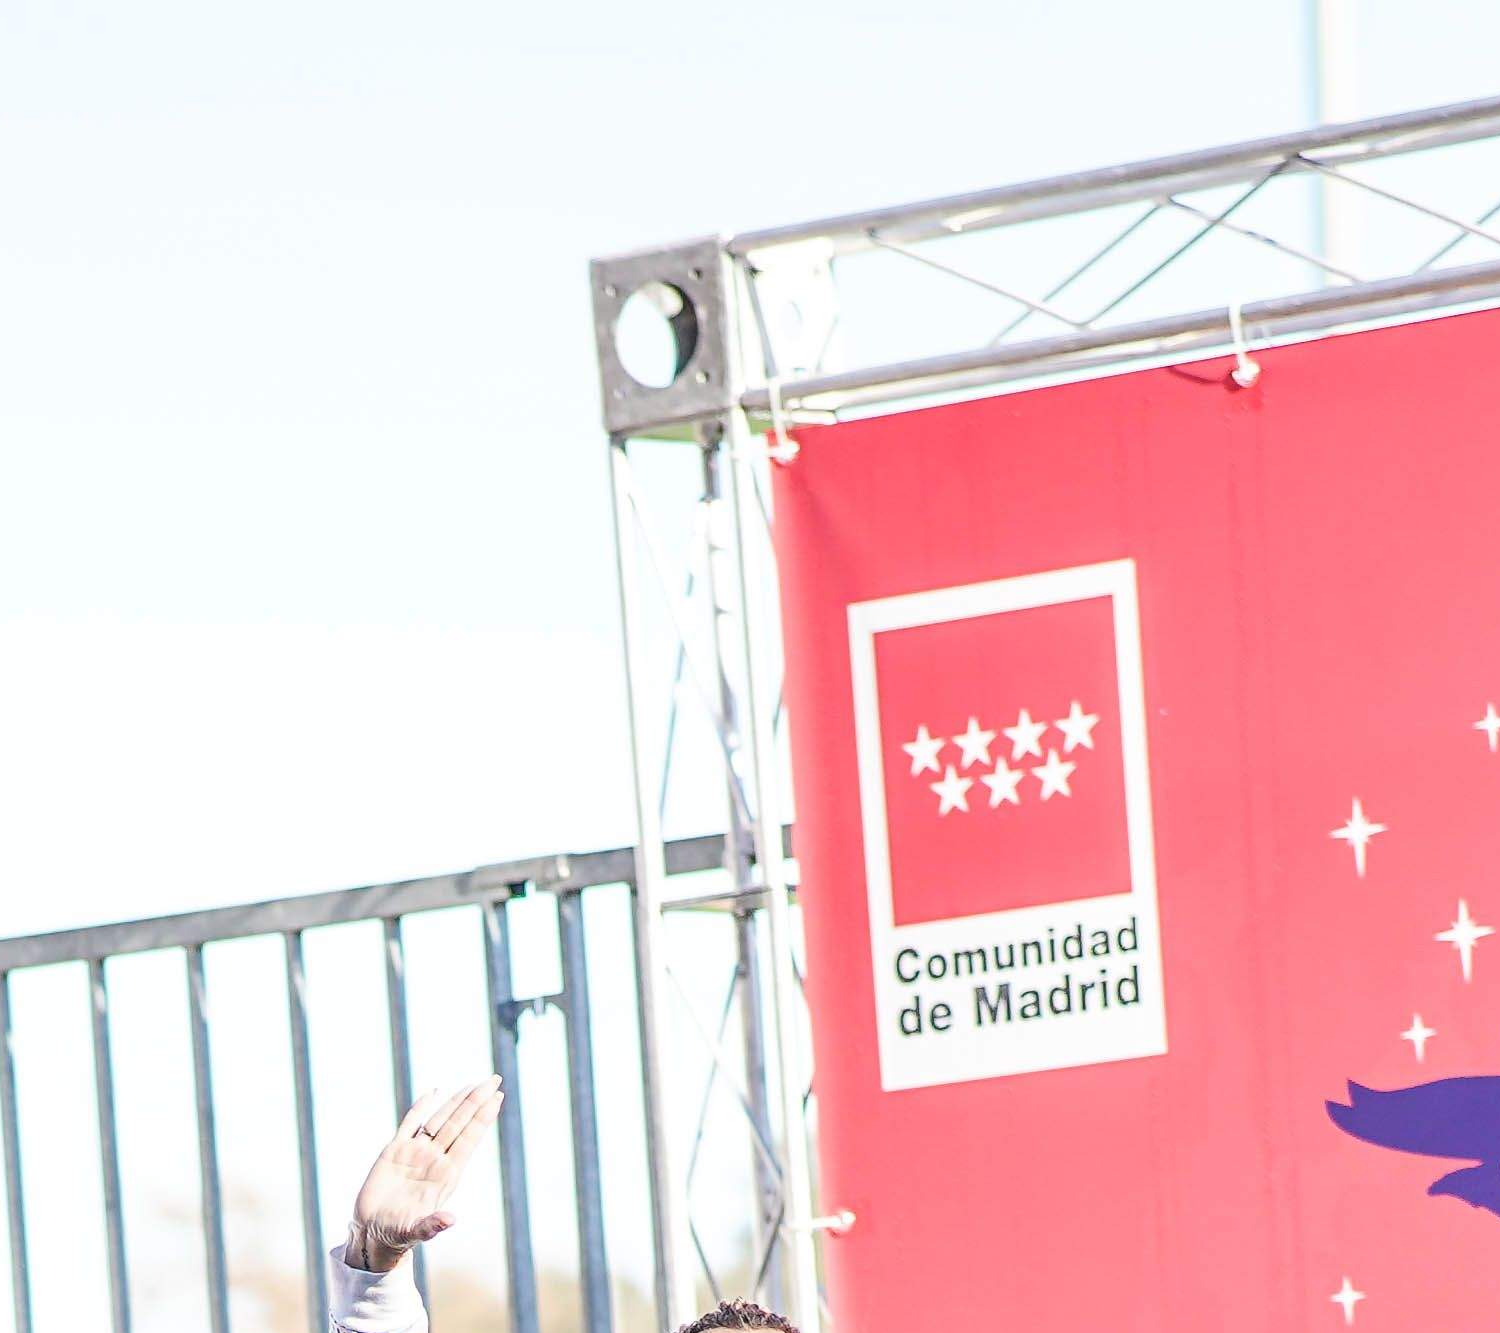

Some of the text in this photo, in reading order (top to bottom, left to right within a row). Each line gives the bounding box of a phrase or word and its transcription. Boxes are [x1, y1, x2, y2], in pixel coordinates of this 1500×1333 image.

[895, 916, 1139, 983] Comunidad
[899, 965, 1141, 1036] de Madrid
